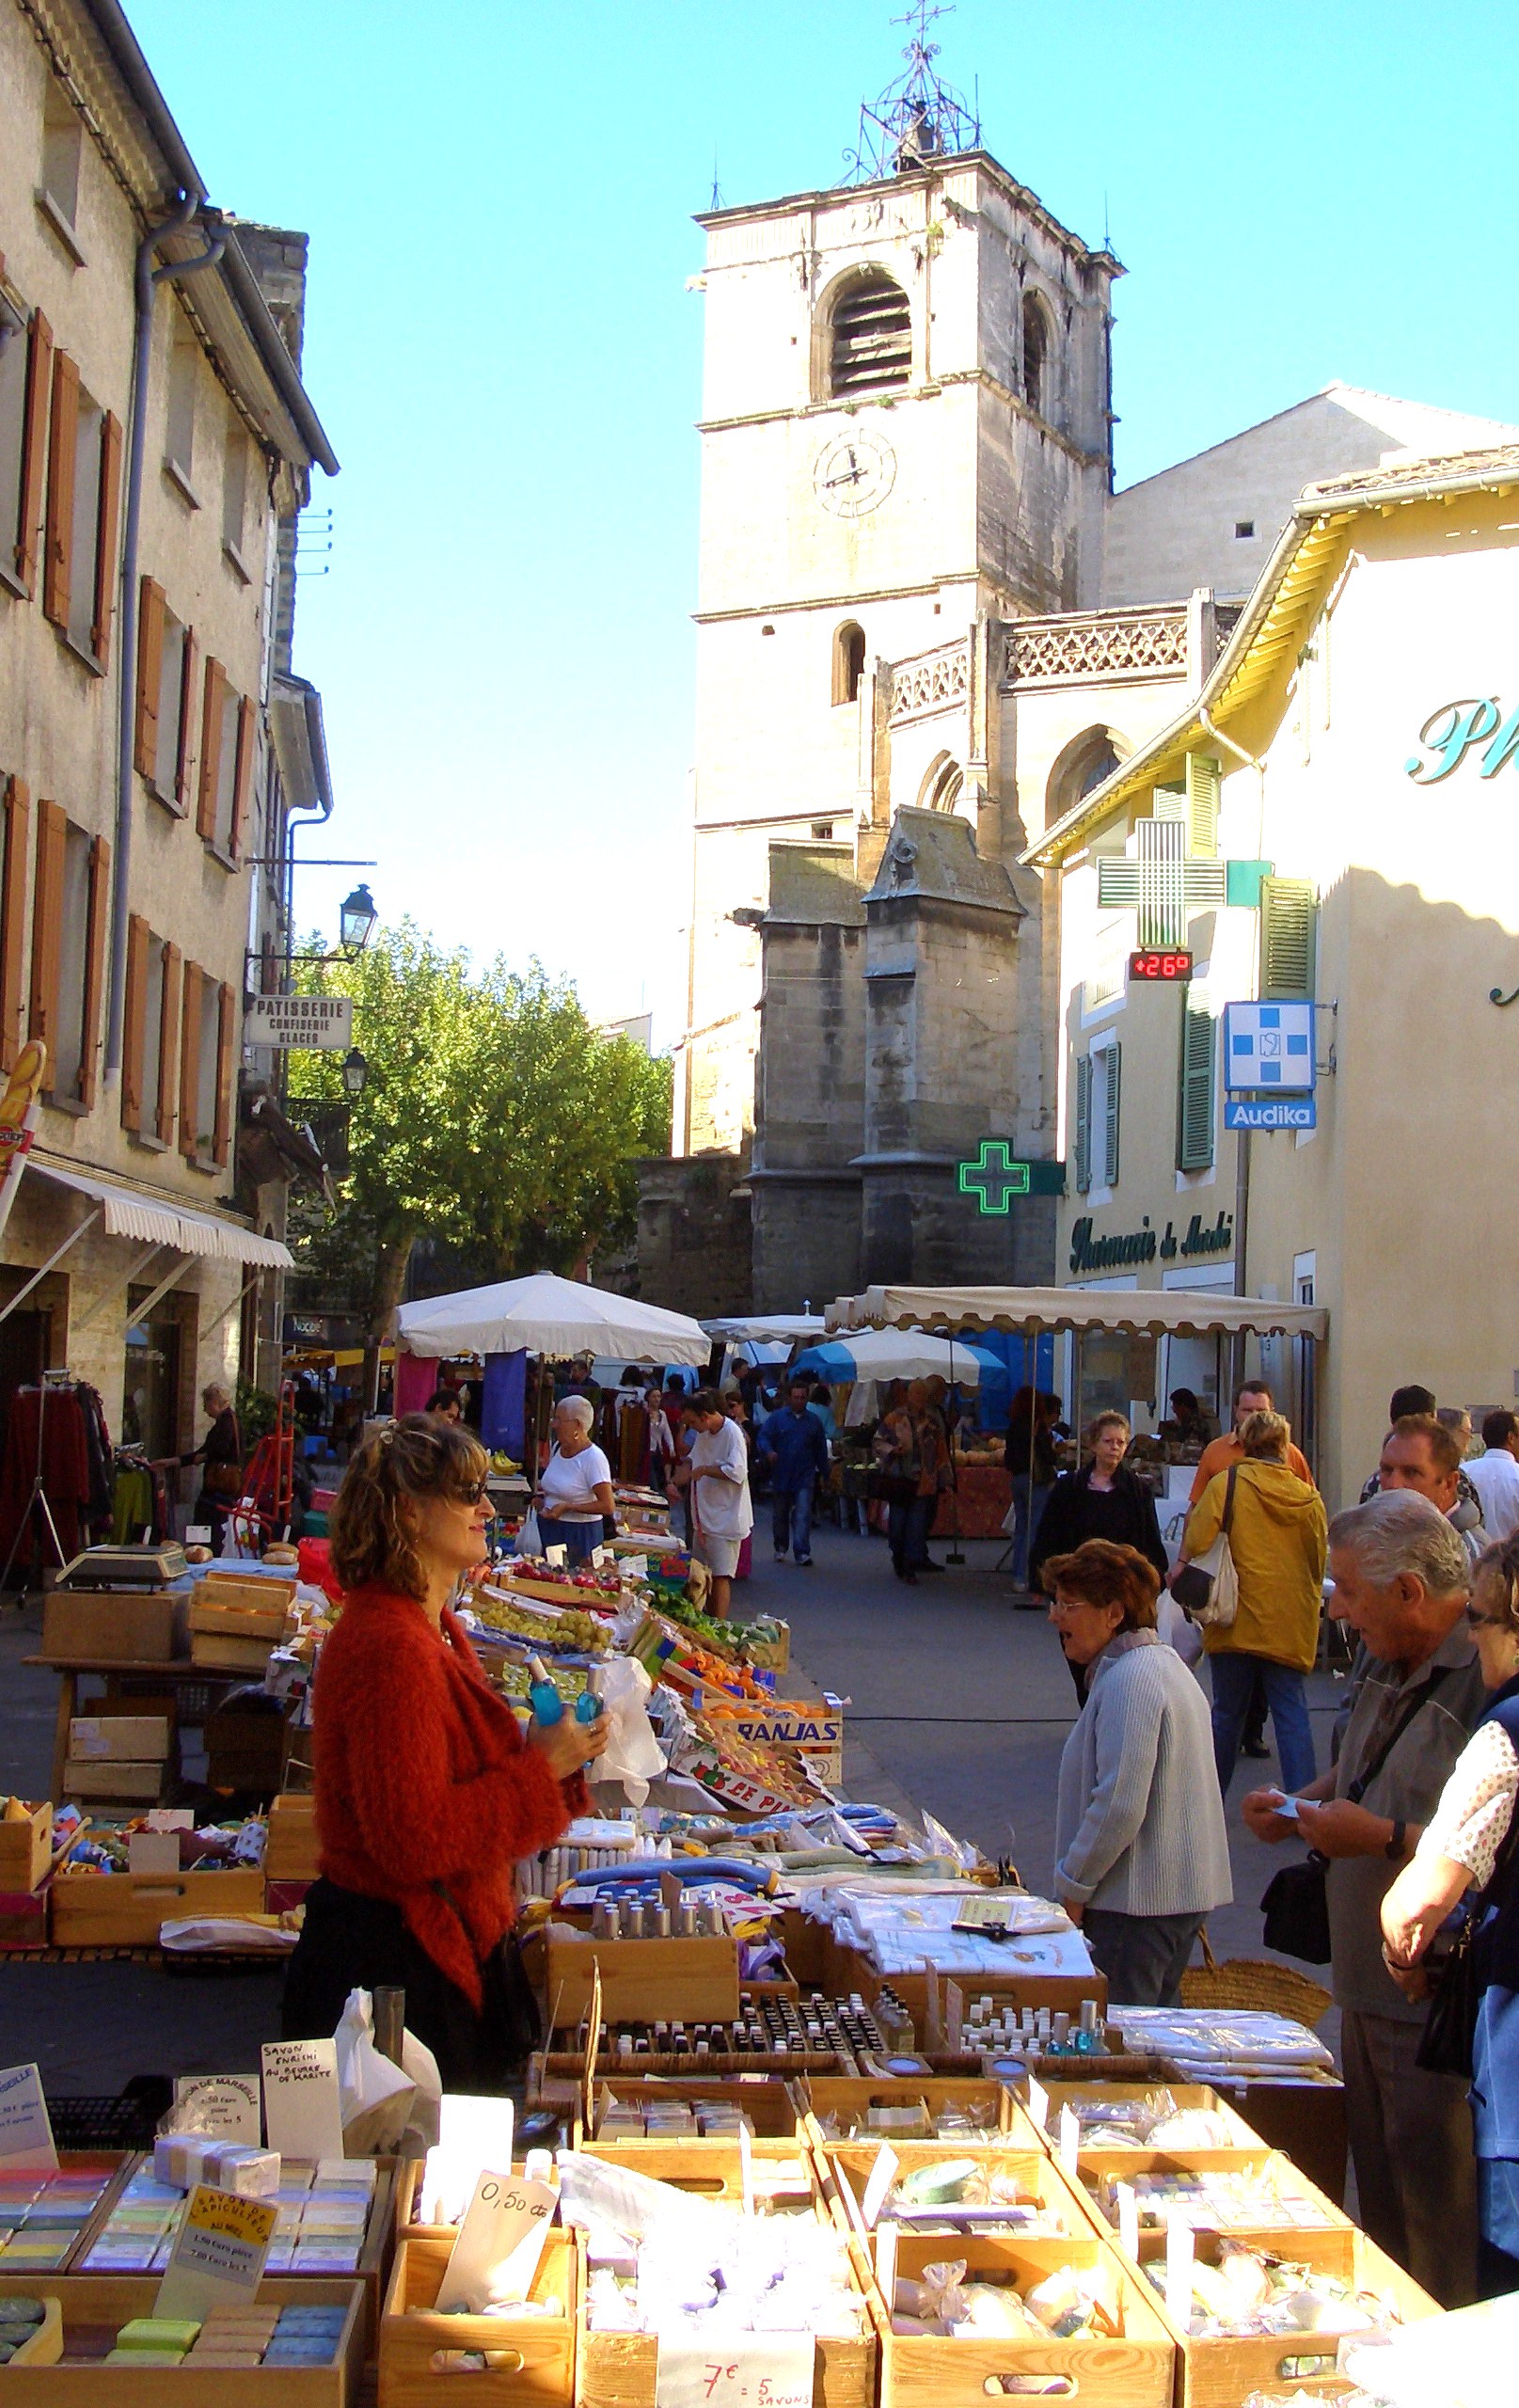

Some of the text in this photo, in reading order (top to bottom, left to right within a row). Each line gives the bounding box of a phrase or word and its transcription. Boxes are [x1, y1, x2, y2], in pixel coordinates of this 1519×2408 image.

[257, 1000, 343, 1018] PATISSERIE
[269, 1018, 330, 1031] CONFISERIE
[279, 1032, 319, 1044] GLACES
[1232, 1105, 1310, 1125] Audika
[263, 2044, 303, 2056] SAVON
[198, 2079, 214, 2087] DE
[215, 2078, 258, 2106] MARSEILLE
[481, 2182, 526, 2210] 0,50
[758, 2379, 772, 2396] 5
[758, 2395, 810, 2406] SAVONS
